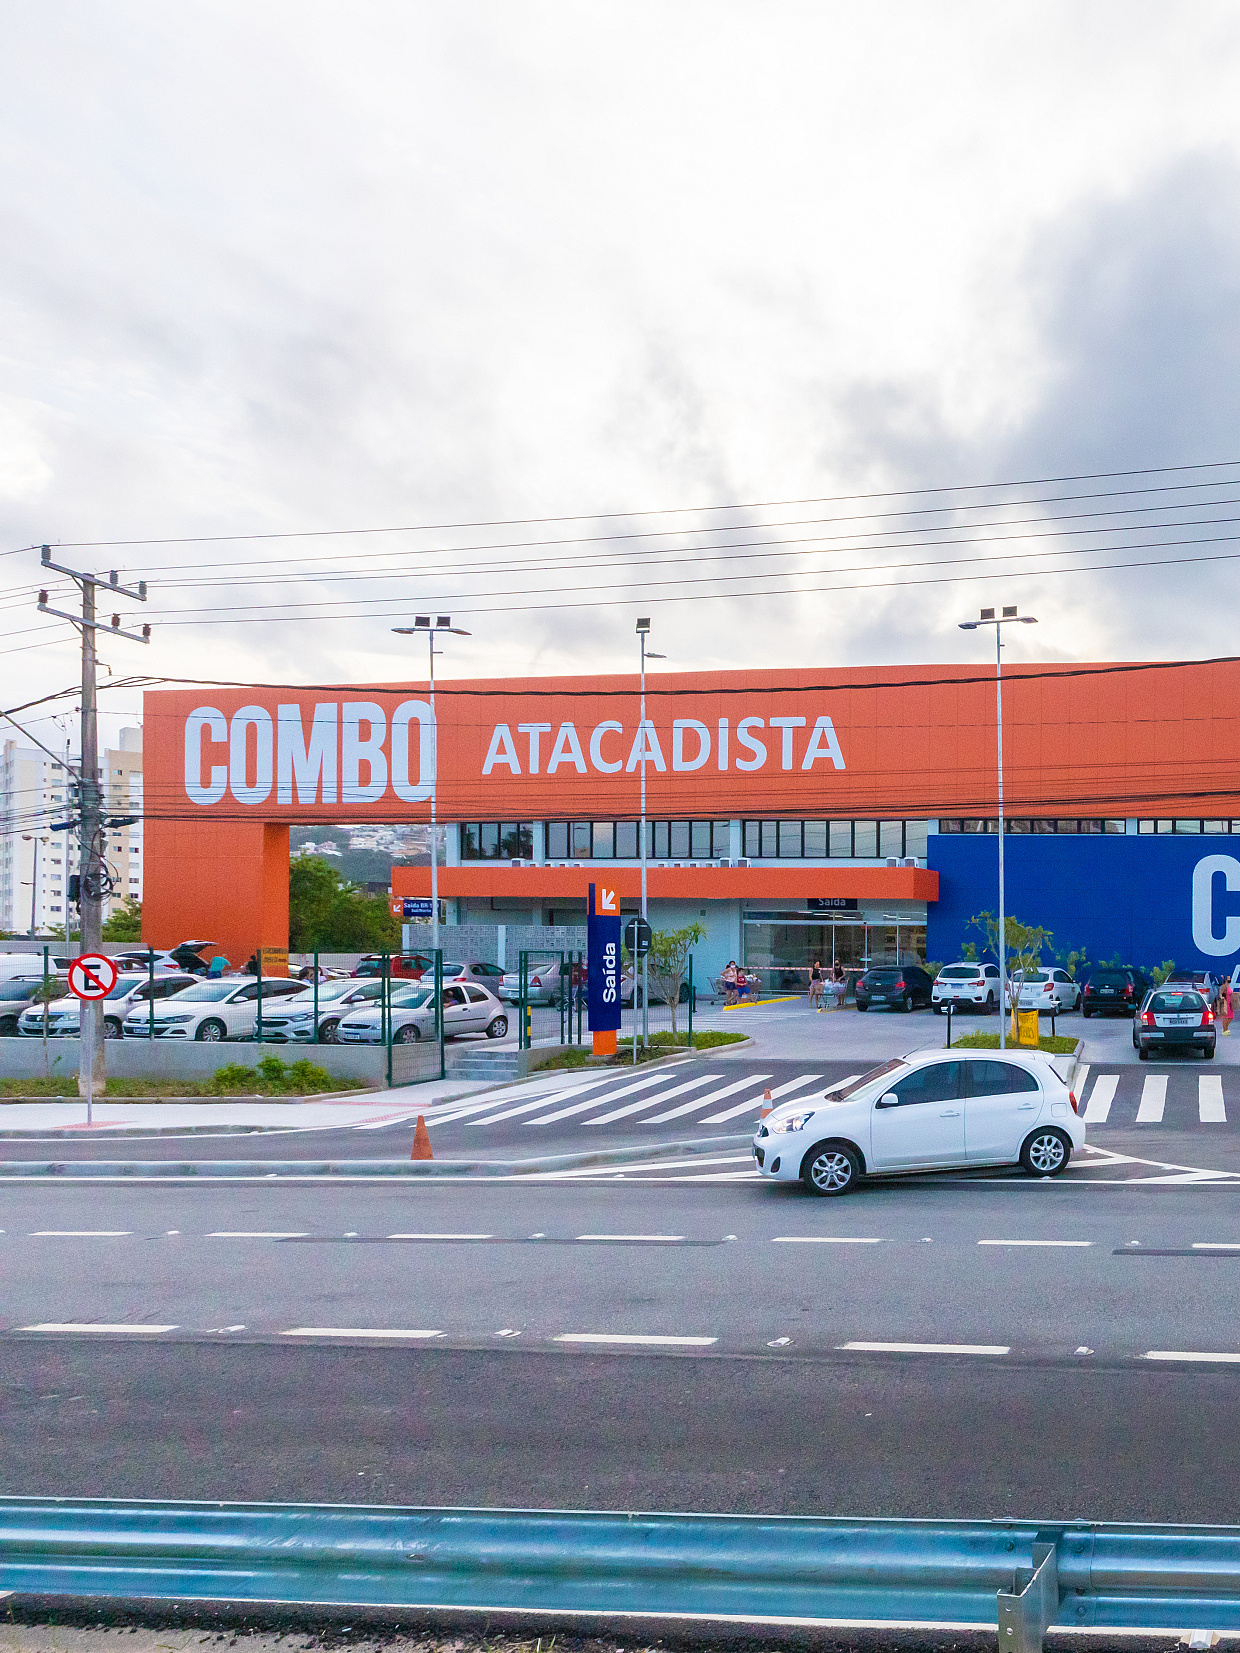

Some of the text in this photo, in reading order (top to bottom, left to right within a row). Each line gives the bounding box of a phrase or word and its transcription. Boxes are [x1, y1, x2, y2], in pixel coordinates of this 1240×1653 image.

[185, 700, 846, 805] COMBO ATACADISTA
[84, 964, 101, 990] E
[602, 942, 616, 1003] Saída
